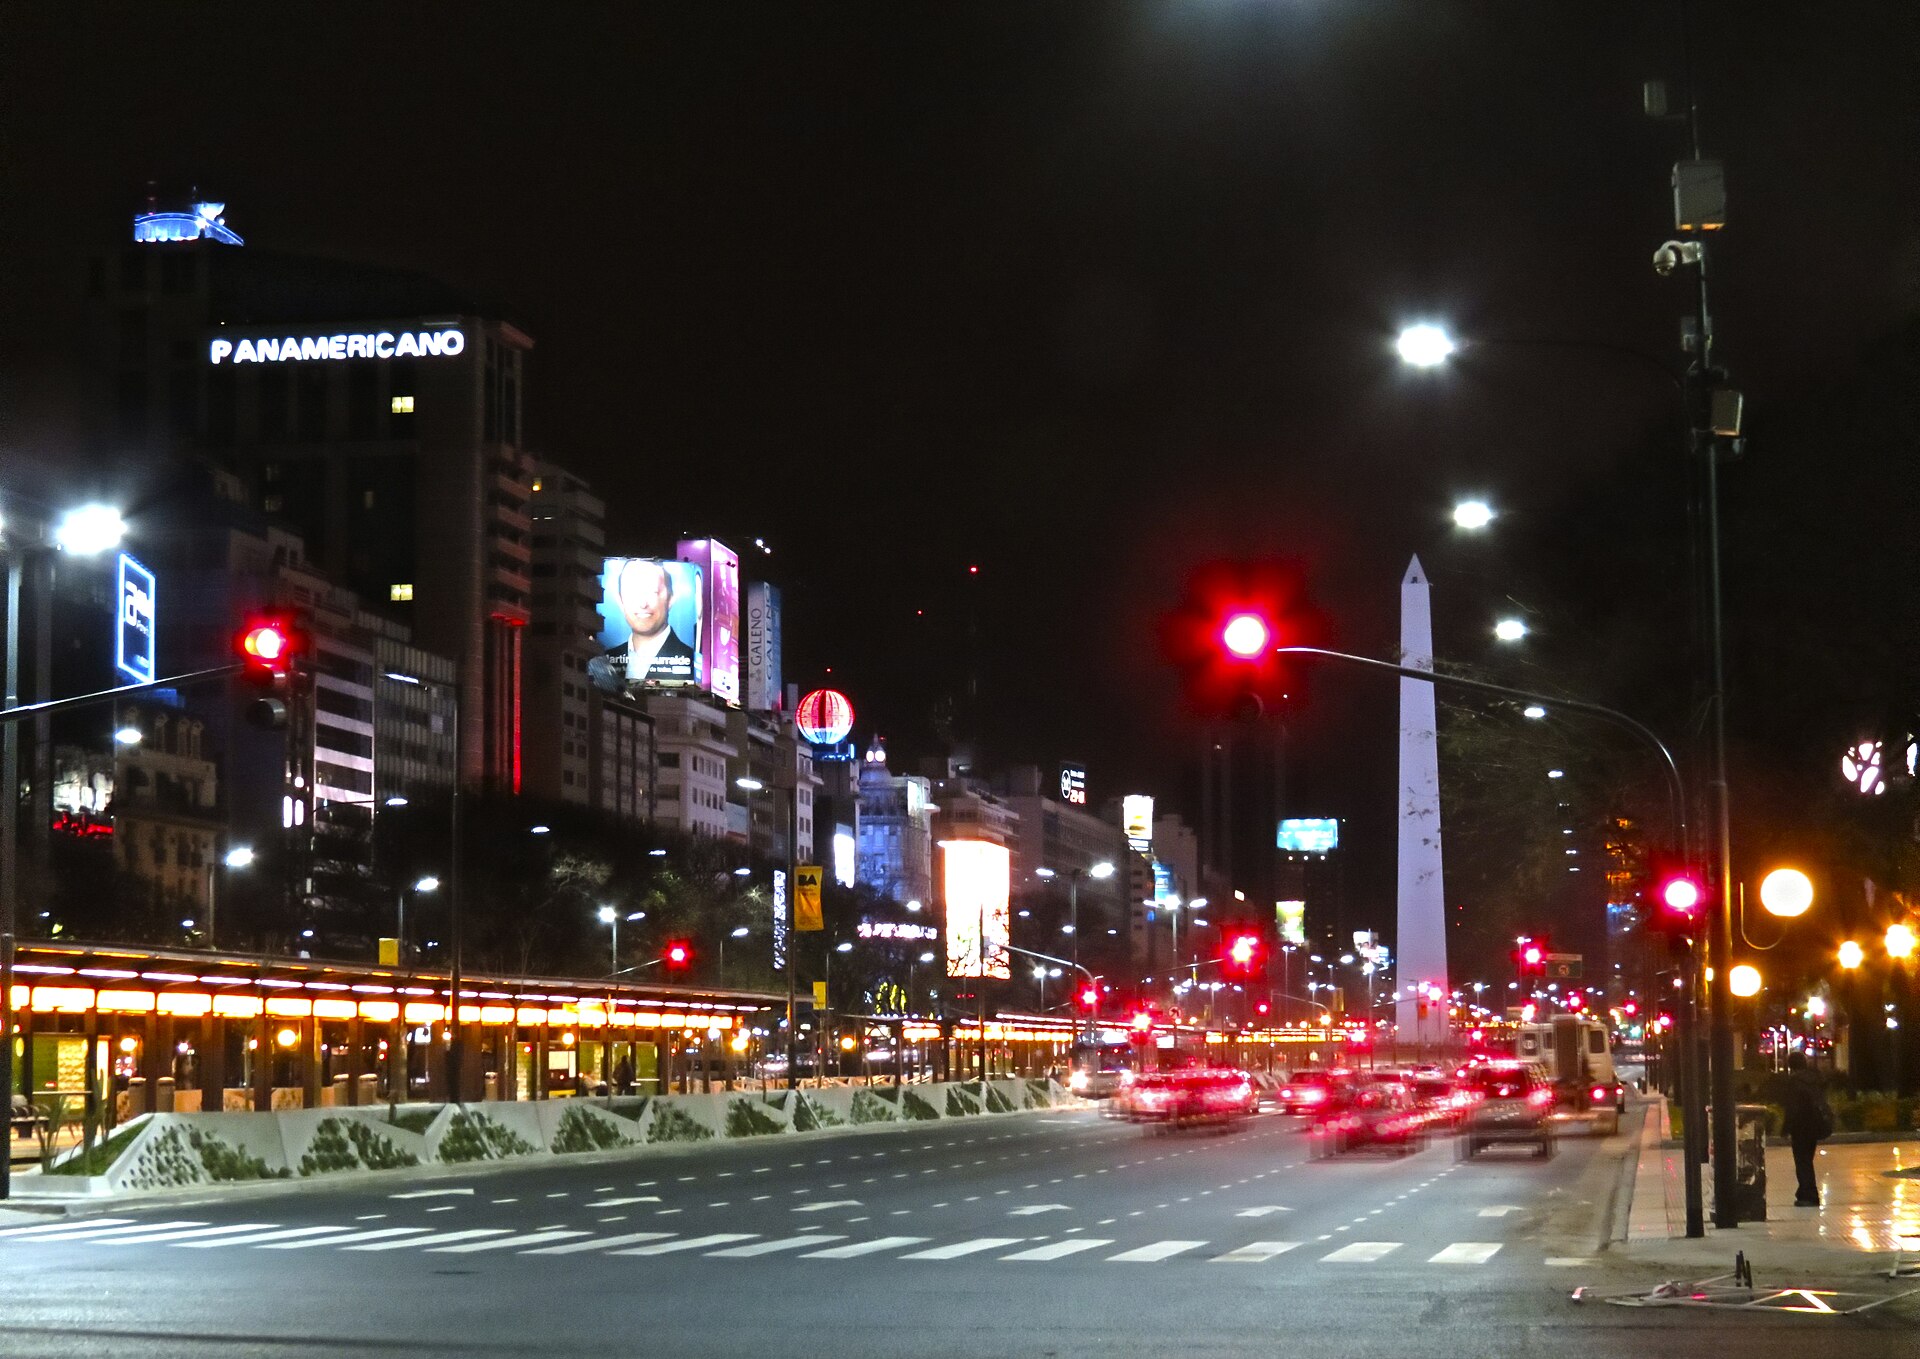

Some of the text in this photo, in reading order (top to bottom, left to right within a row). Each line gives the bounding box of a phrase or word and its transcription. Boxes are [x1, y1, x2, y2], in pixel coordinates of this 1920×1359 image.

[210, 330, 465, 364] PANAMERICANO
[750, 608, 762, 666] GALENO
[798, 874, 818, 886] BA
